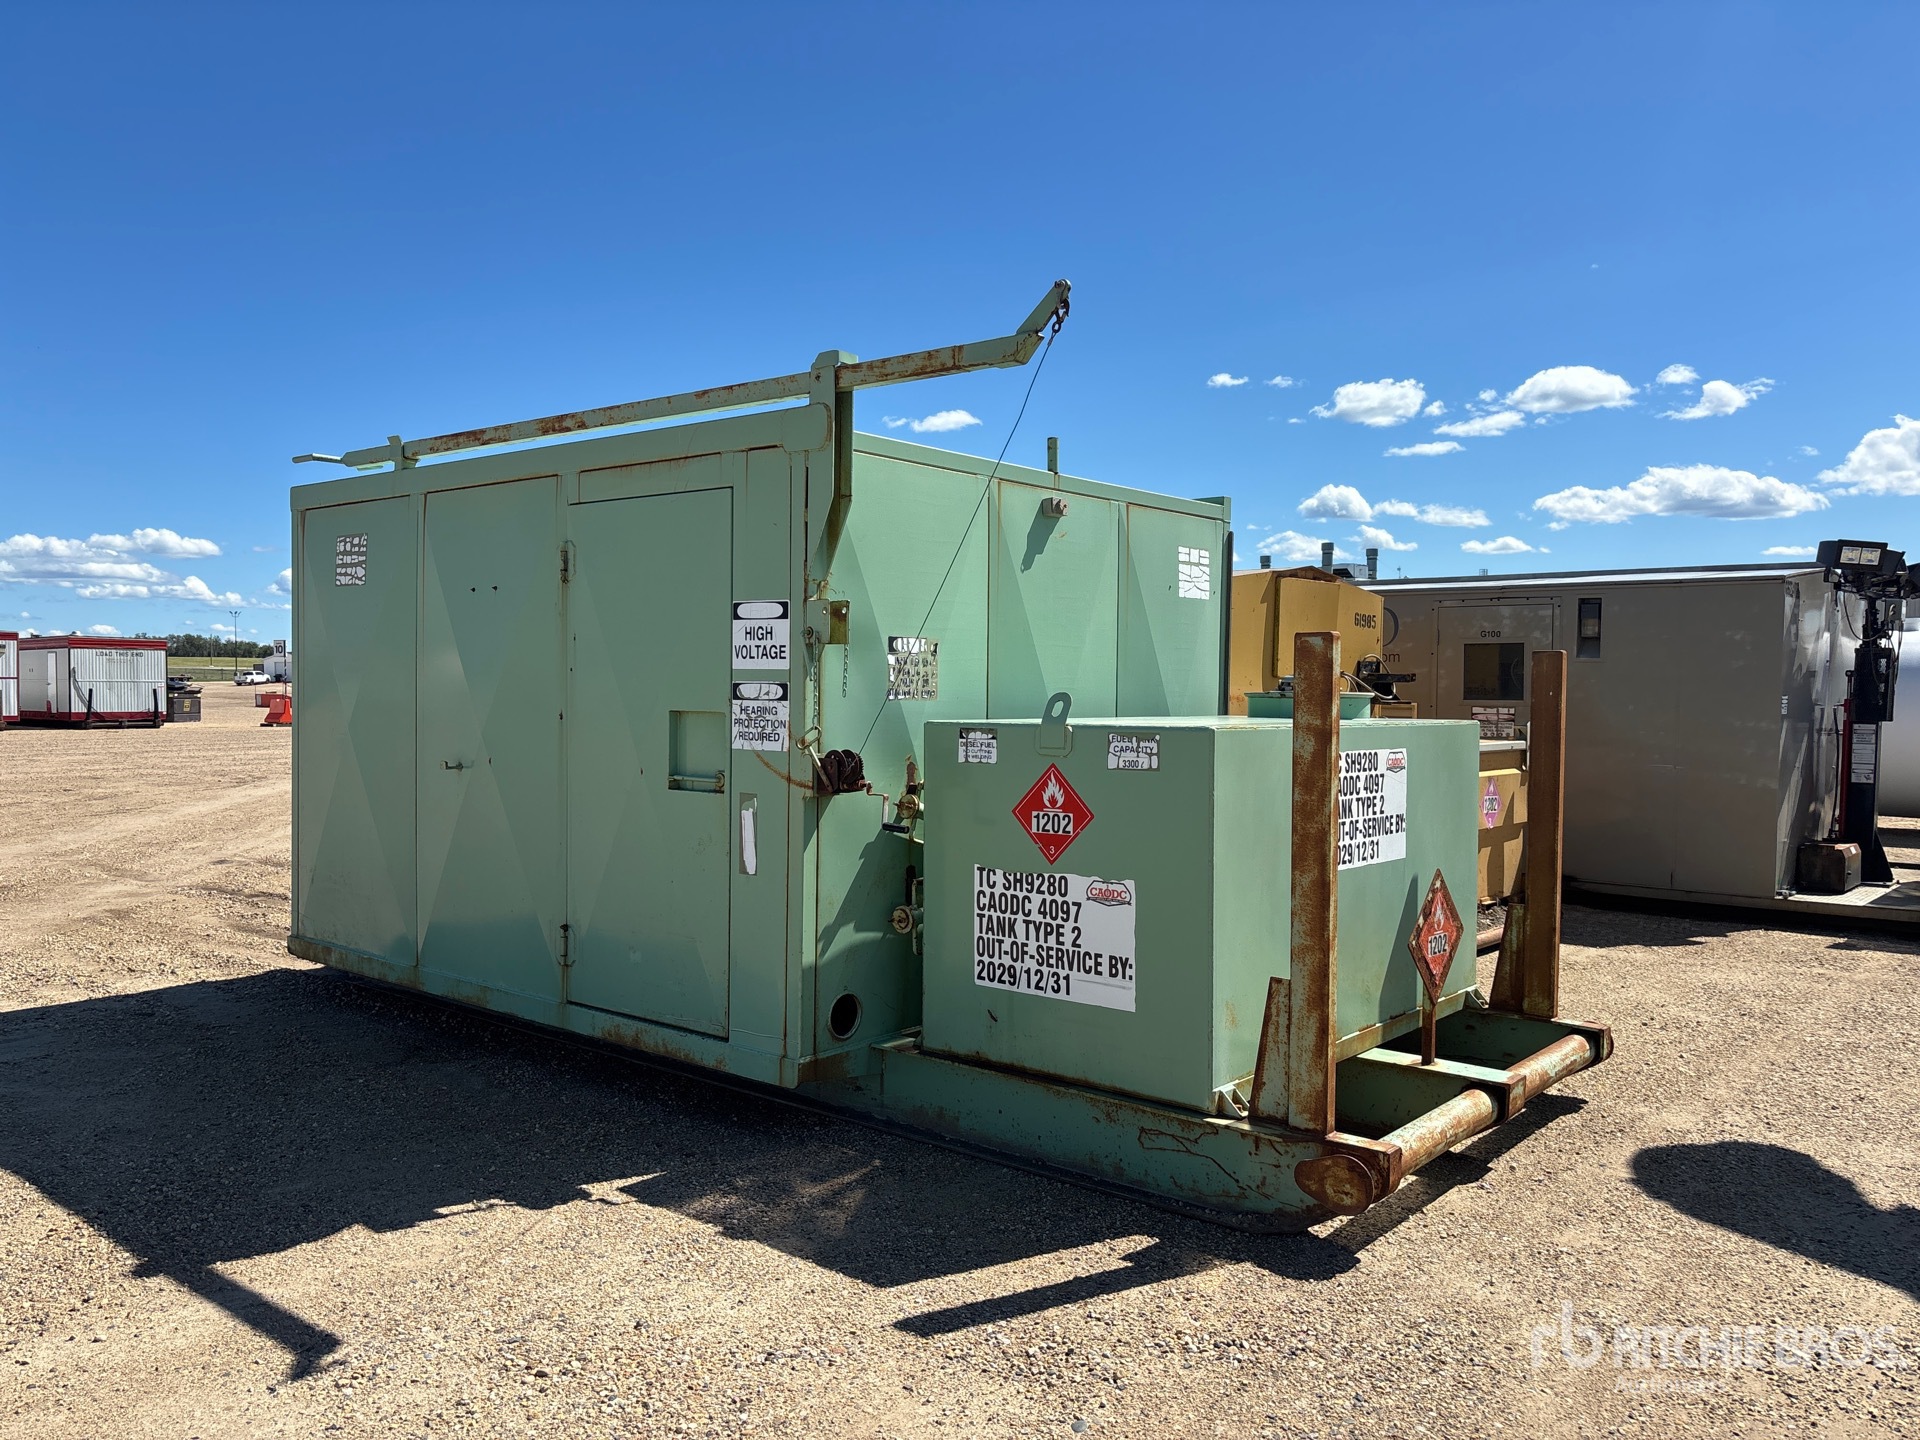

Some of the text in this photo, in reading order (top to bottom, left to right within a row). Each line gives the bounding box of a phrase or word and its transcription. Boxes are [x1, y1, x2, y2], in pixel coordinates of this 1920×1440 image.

[744, 626, 773, 641] HIGH
[1480, 630, 1501, 638] G100
[274, 645, 284, 654] 10
[734, 644, 787, 660] VOLTAGE
[1382, 652, 1400, 663] om
[739, 705, 778, 717] HEARING
[733, 718, 787, 730] PROTECTION
[738, 731, 780, 742] REQUIRED
[1111, 735, 1132, 743] FUEL
[980, 741, 995, 749] FUEL
[1113, 744, 1155, 754] CAPACITY
[1122, 759, 1140, 769] 3300
[1345, 751, 1378, 774] SH9280
[1387, 757, 1404, 767] CAODC
[1338, 773, 1385, 798] AODC 4097
[1355, 796, 1377, 818] TYPE
[1379, 795, 1385, 815] 2
[1032, 812, 1072, 835] 1202
[1338, 812, 1406, 843] T-OF-SERVICE BY:
[1049, 845, 1055, 855] 3
[976, 866, 1069, 897] TC SH9280
[1089, 886, 1128, 900] CAODC
[976, 889, 1082, 924] CAODC 4097
[976, 912, 1082, 949] TANK TYPE 2
[1428, 934, 1448, 956] 1202
[976, 936, 1134, 981] OUT-OF-SERVICE BY:
[976, 958, 1072, 997] 2029/12/31
